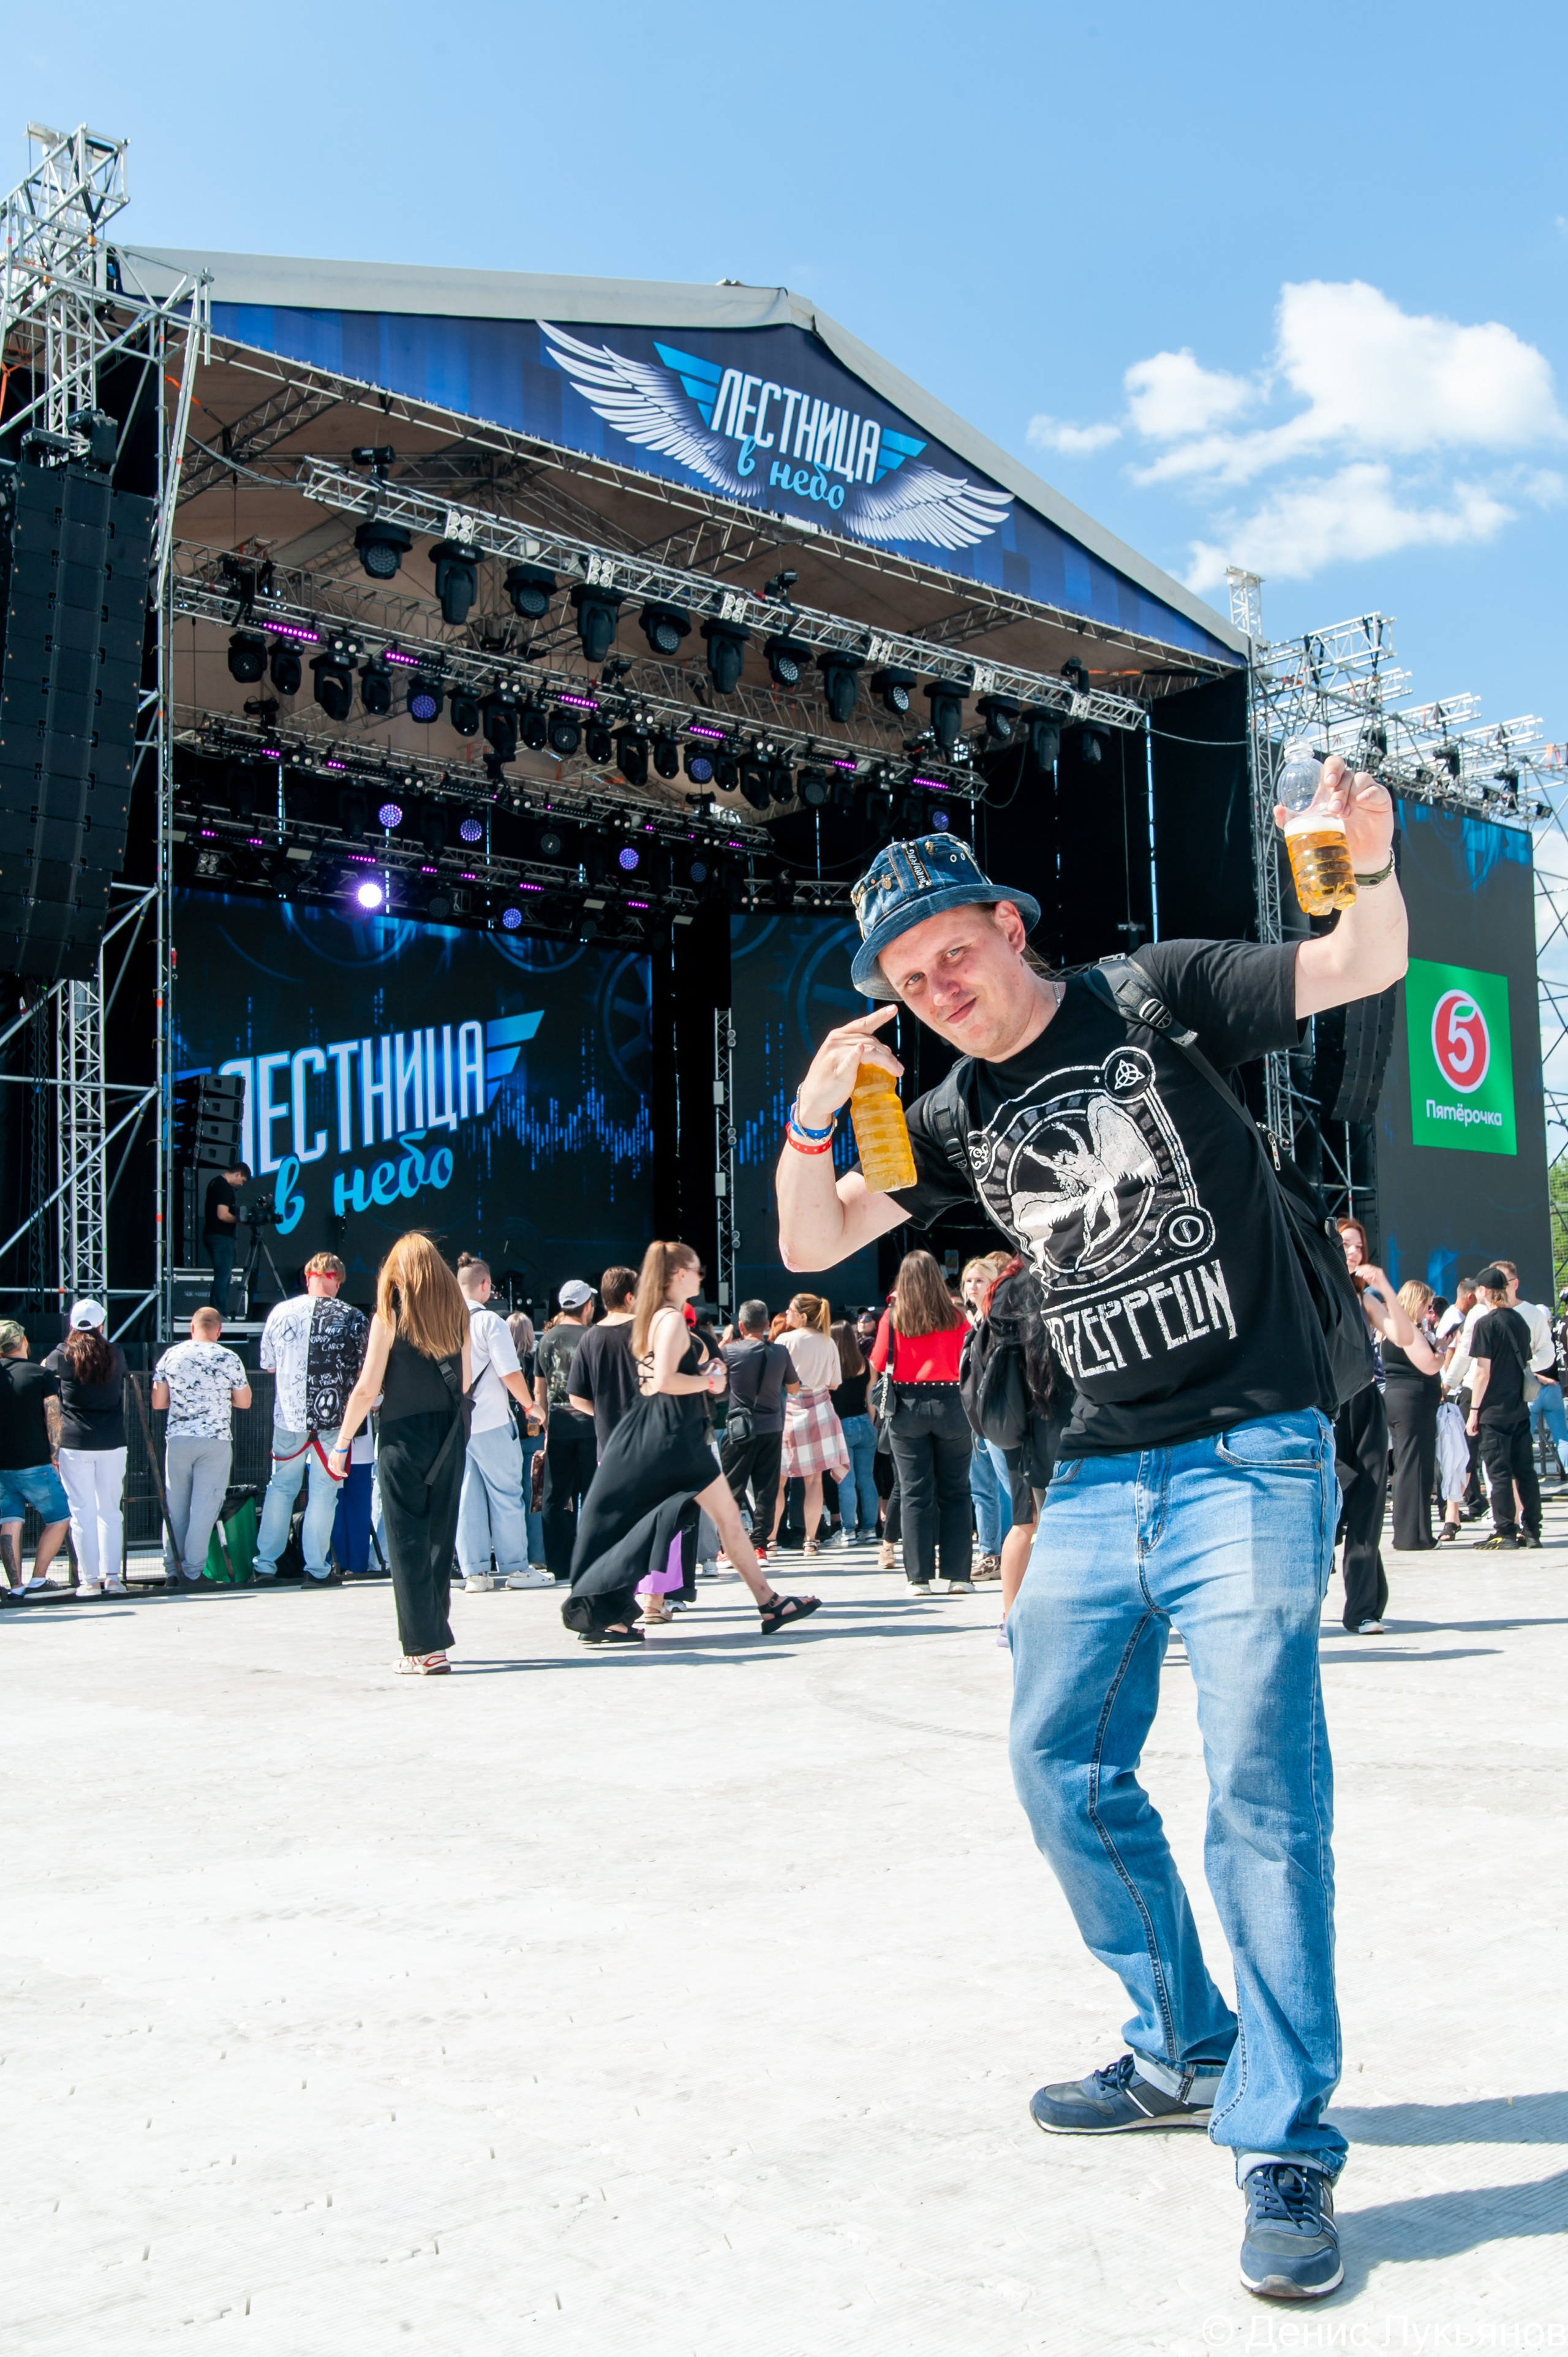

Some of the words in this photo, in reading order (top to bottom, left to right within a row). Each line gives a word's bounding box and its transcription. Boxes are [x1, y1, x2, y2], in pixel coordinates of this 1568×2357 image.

[710, 368, 881, 485] ЛЕСТНИЦА
[737, 436, 756, 477] в
[769, 461, 845, 510] небо
[1448, 1001, 1477, 1073] 5
[1426, 1099, 1502, 1127] Пятёрочка
[274, 1156, 305, 1235] в
[334, 1130, 453, 1217] небо
